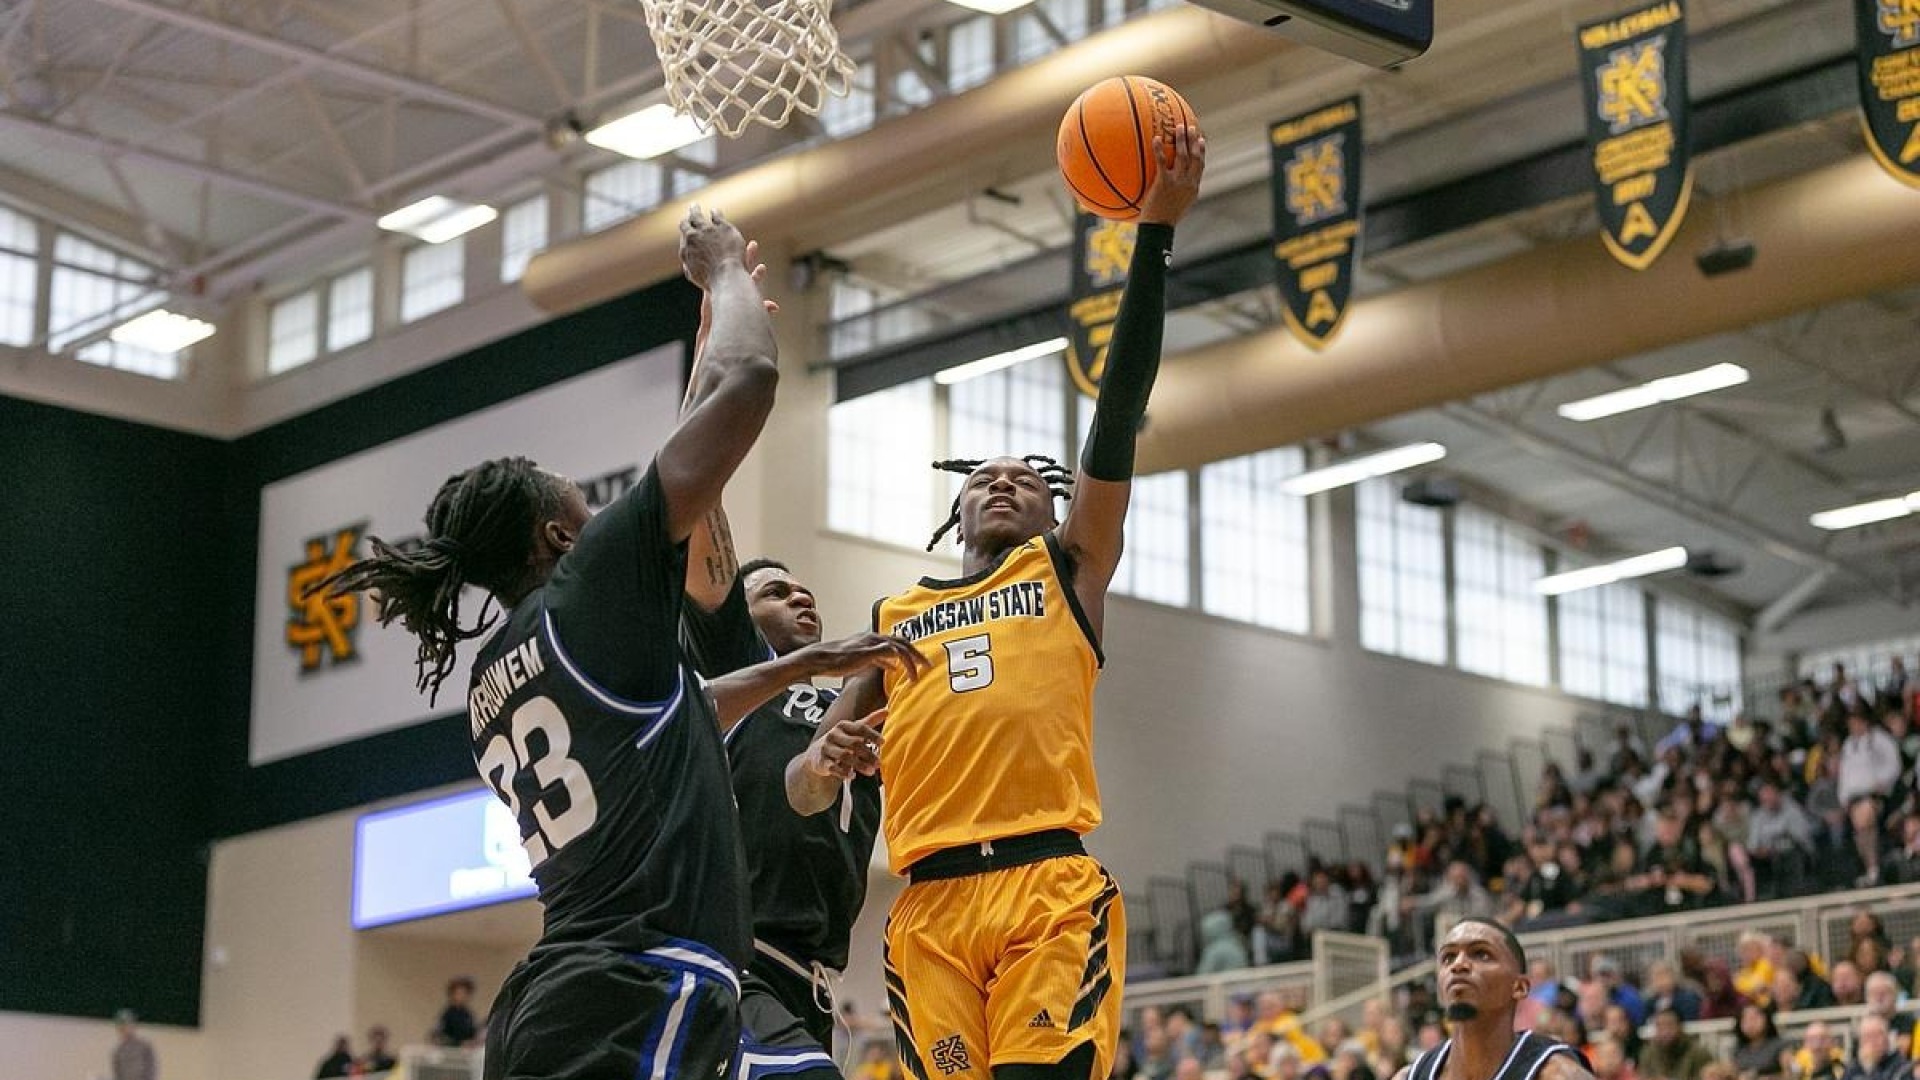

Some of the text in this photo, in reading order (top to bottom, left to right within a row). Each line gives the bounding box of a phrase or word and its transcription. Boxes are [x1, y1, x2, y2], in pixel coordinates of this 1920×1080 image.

[989, 581, 1046, 620] STATE
[942, 632, 995, 694] 5
[782, 682, 825, 724] Pa
[478, 695, 598, 869] 23
